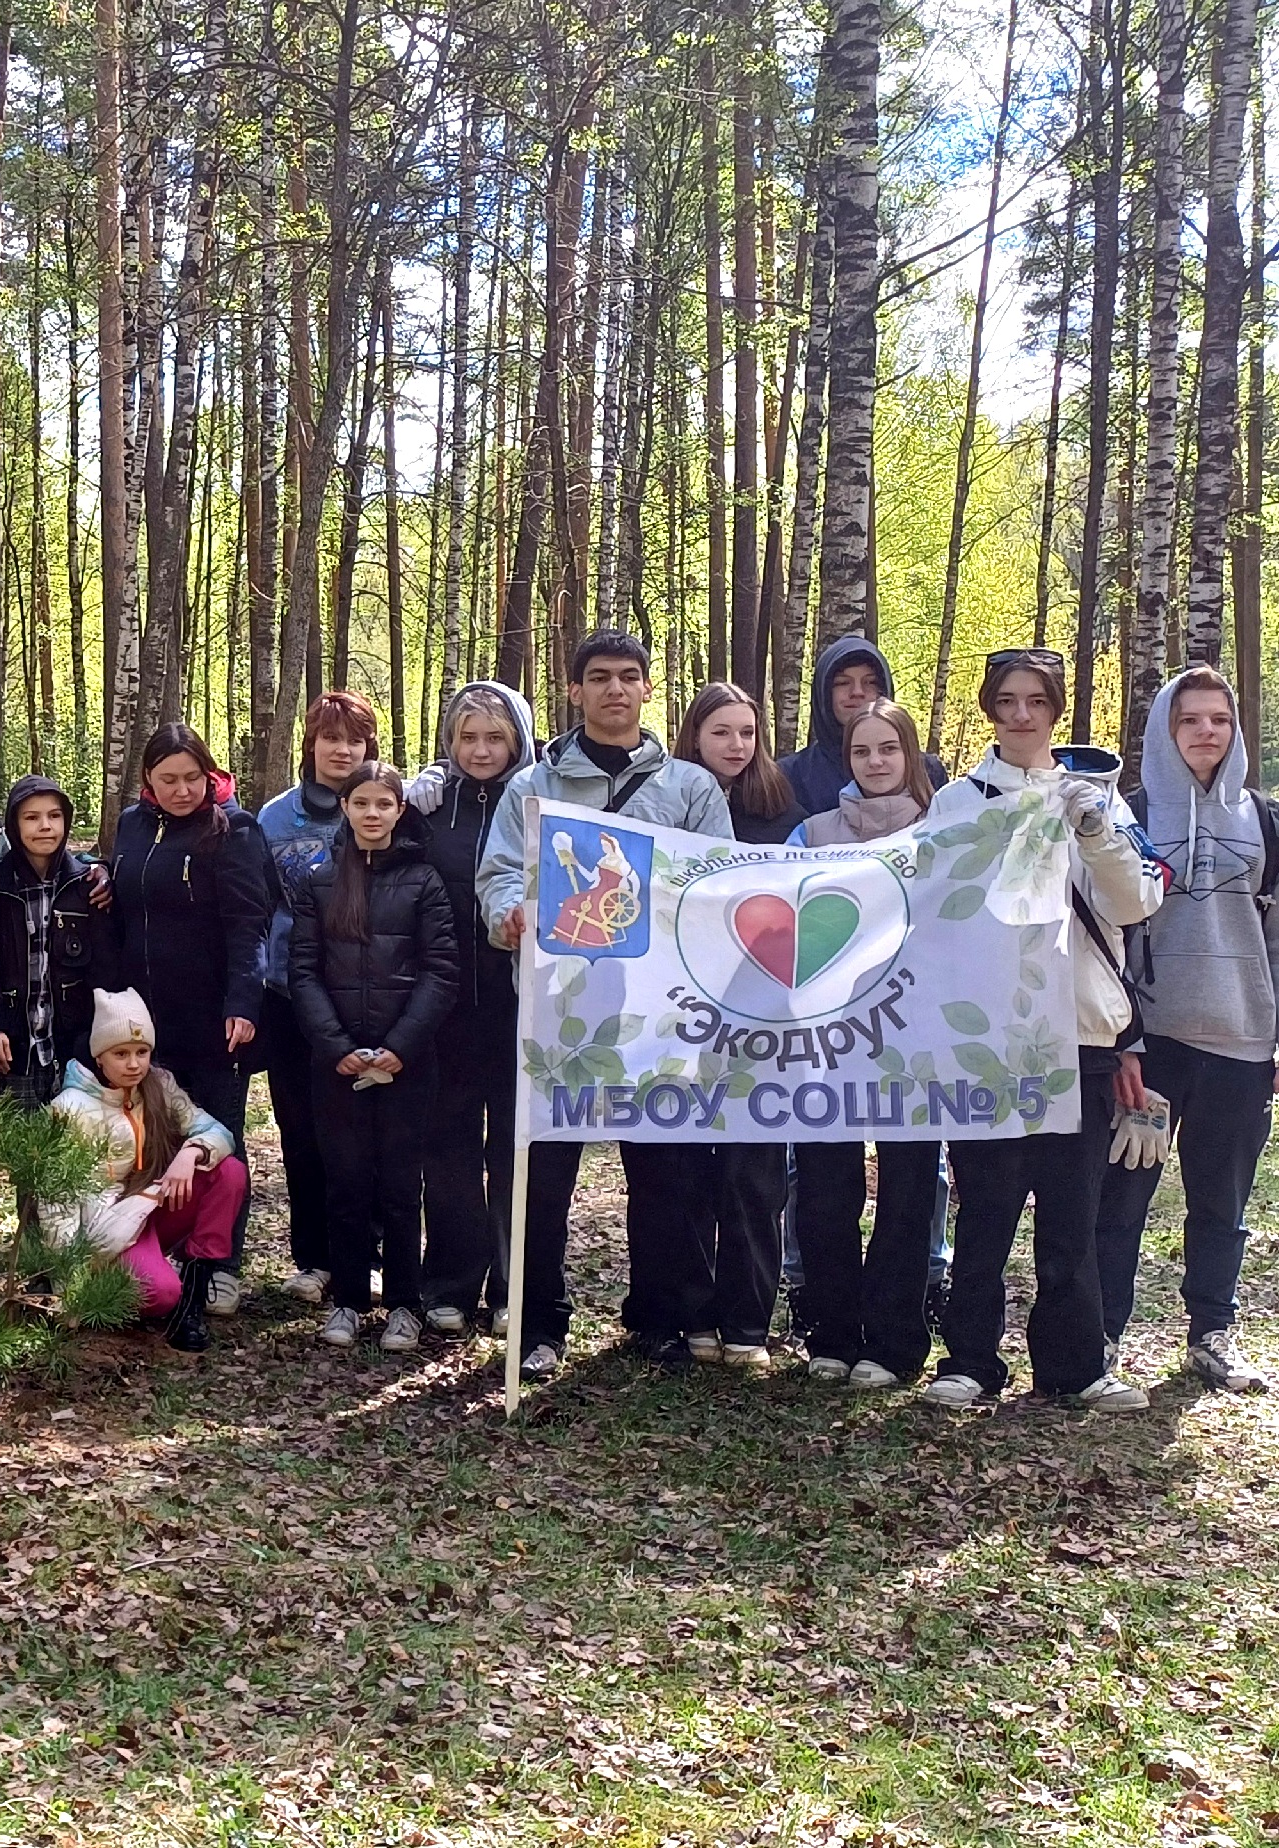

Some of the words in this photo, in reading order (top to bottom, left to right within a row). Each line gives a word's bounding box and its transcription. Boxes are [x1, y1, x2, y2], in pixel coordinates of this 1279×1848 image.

[670, 850, 776, 888] ШКОЛЬНОЕ
[551, 1083, 729, 1129] МБОУ
[747, 1081, 905, 1128] СОШ
[928, 1078, 998, 1125] №
[1018, 1075, 1047, 1122] 5
